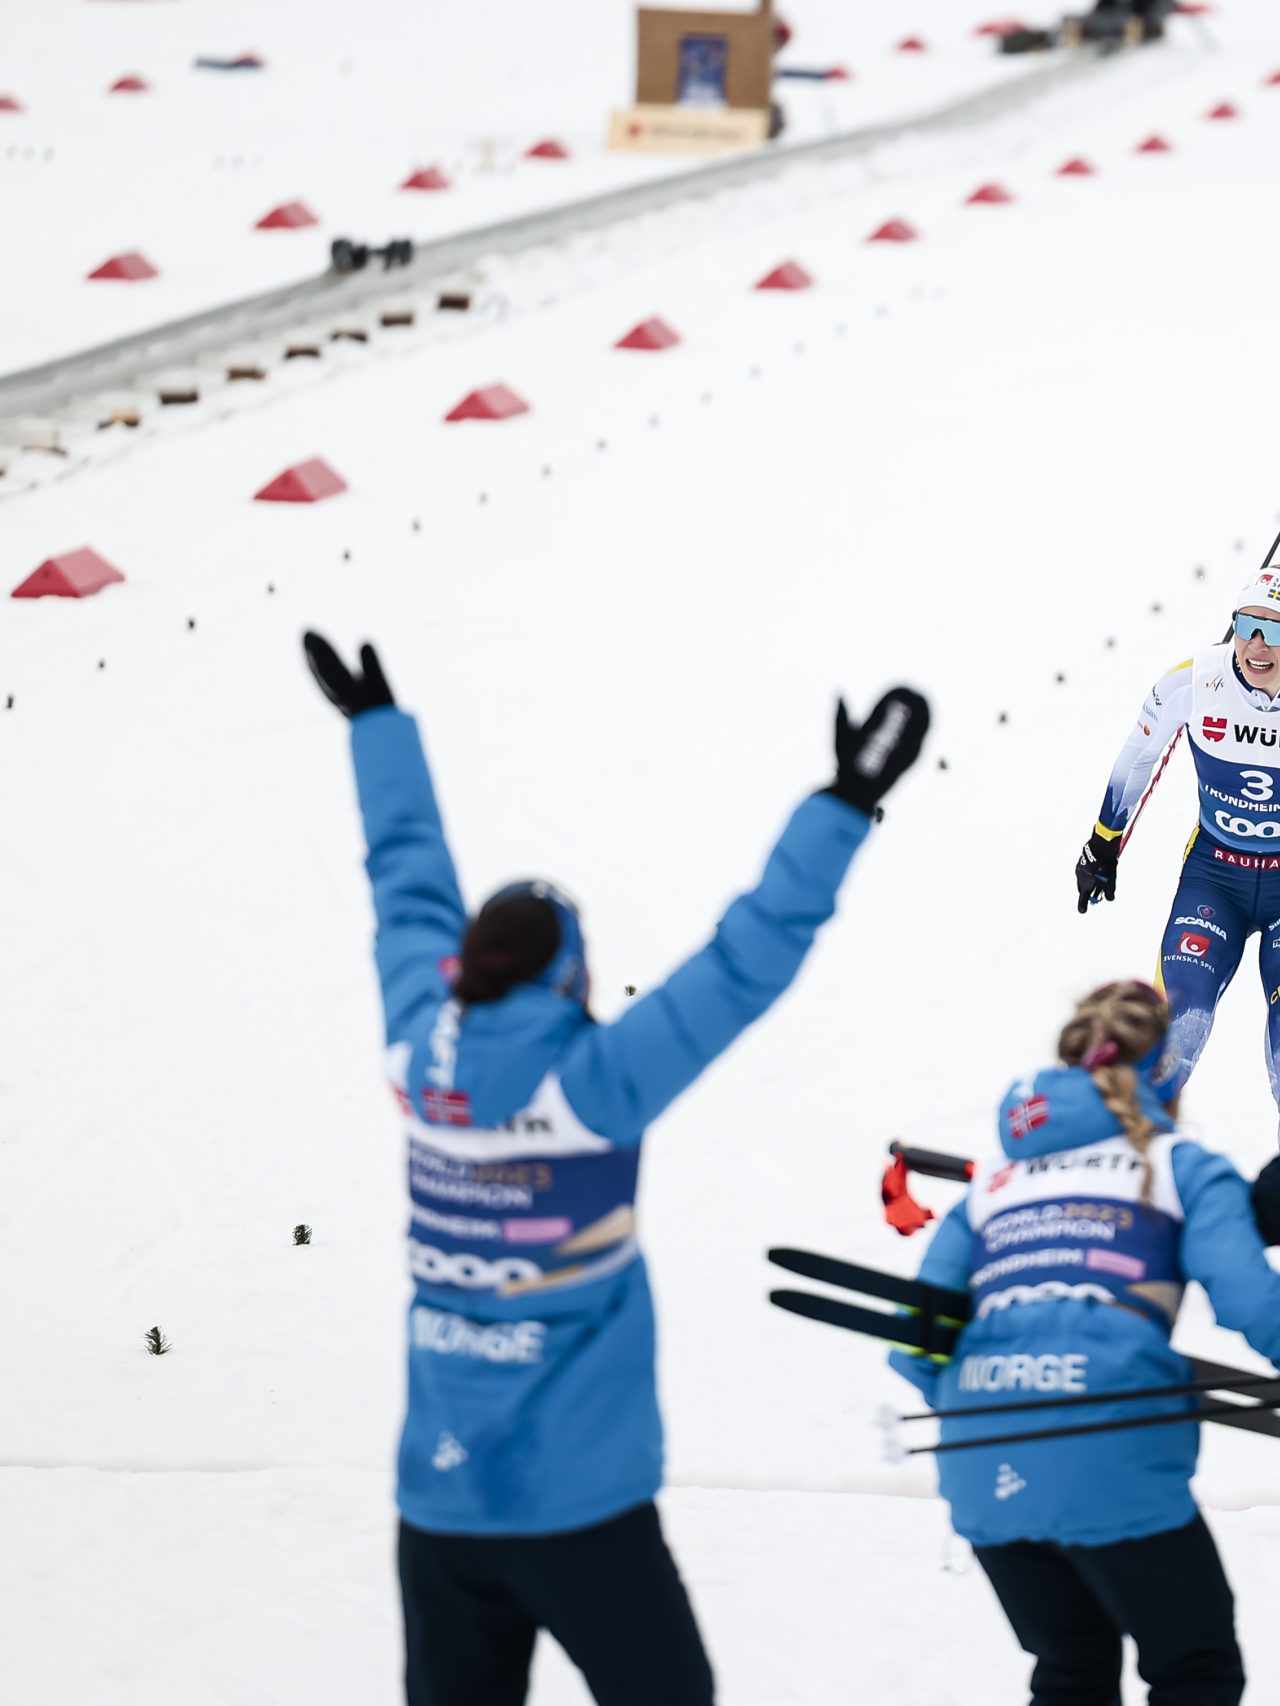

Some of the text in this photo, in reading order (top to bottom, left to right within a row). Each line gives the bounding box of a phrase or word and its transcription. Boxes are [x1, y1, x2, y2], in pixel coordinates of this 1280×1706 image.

[1239, 769, 1274, 801] 3
[1174, 916, 1227, 941] SCANIA
[1163, 954, 1216, 974] SVENSKA SPEL
[959, 1353, 1089, 1393] NORGE
